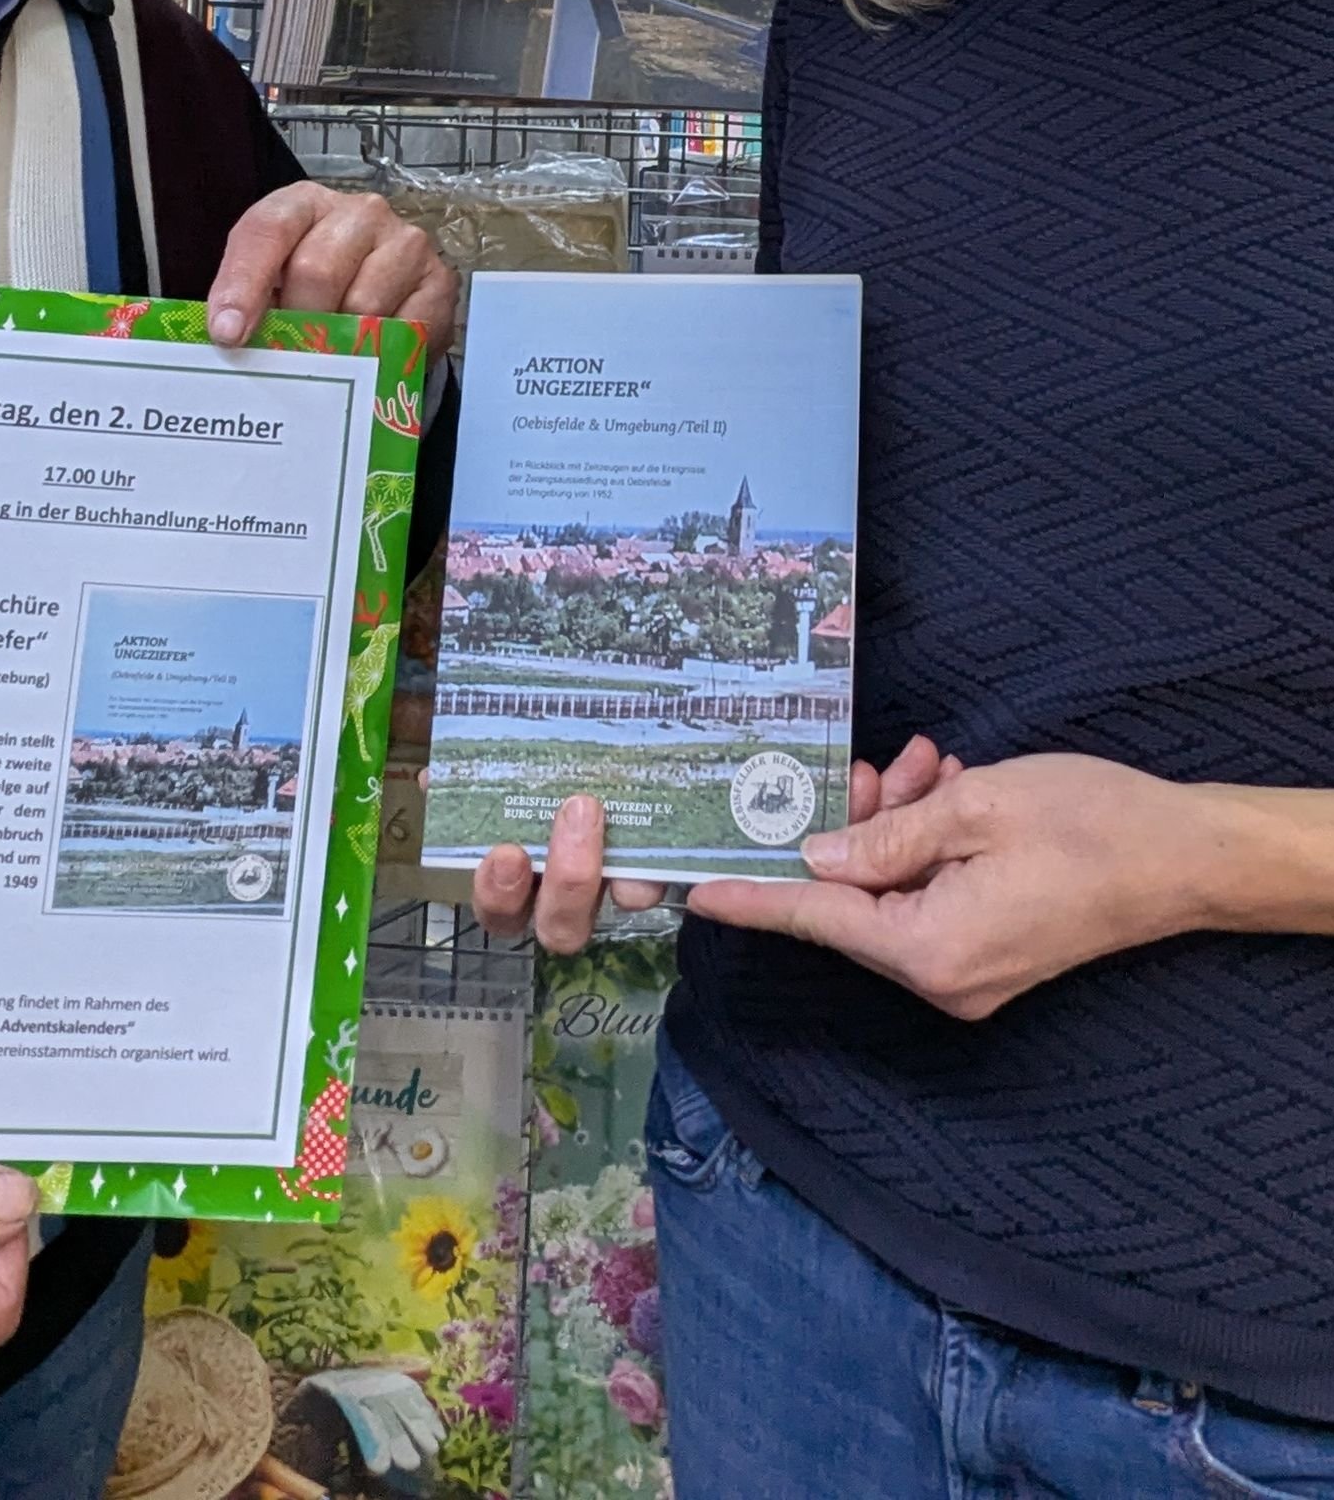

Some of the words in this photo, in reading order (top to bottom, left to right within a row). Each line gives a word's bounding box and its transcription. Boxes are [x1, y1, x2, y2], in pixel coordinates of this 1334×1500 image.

[513, 356, 605, 377] „AKTION
[516, 378, 652, 398] UNGEZIEFER“
[49, 399, 100, 429] den
[109, 405, 134, 430] 2.
[143, 406, 285, 442] Dezember
[512, 415, 586, 434] (Oebisfelde
[588, 418, 600, 432] &
[604, 418, 709, 437] Umgebung/Teil
[712, 419, 727, 438] II)
[43, 465, 96, 486] 17.00
[101, 469, 136, 489] Uhr
[16, 500, 33, 518] in
[37, 502, 70, 520] der
[75, 505, 308, 537] Buchhandlung-Hoffmann
[113, 635, 169, 648] „AKTION
[114, 648, 195, 662] UNGEZIEFER“
[20, 734, 55, 749] stellt
[4, 757, 53, 772] zweite
[25, 781, 51, 795] auf
[13, 803, 47, 819] dem
[505, 796, 564, 808] OEBISFELD
[602, 799, 652, 812] ATVEREIN
[504, 807, 536, 819] BURG-
[540, 810, 555, 820] UN
[17, 854, 41, 865] um
[3, 874, 39, 890] 1949
[18, 994, 60, 1010] findet
[62, 995, 81, 1010] im
[84, 996, 142, 1012] Rahmen
[145, 997, 170, 1012] des
[0, 1018, 136, 1036] Adventskalenders“
[120, 1046, 195, 1063] organisiert
[197, 1047, 232, 1063] wird.
